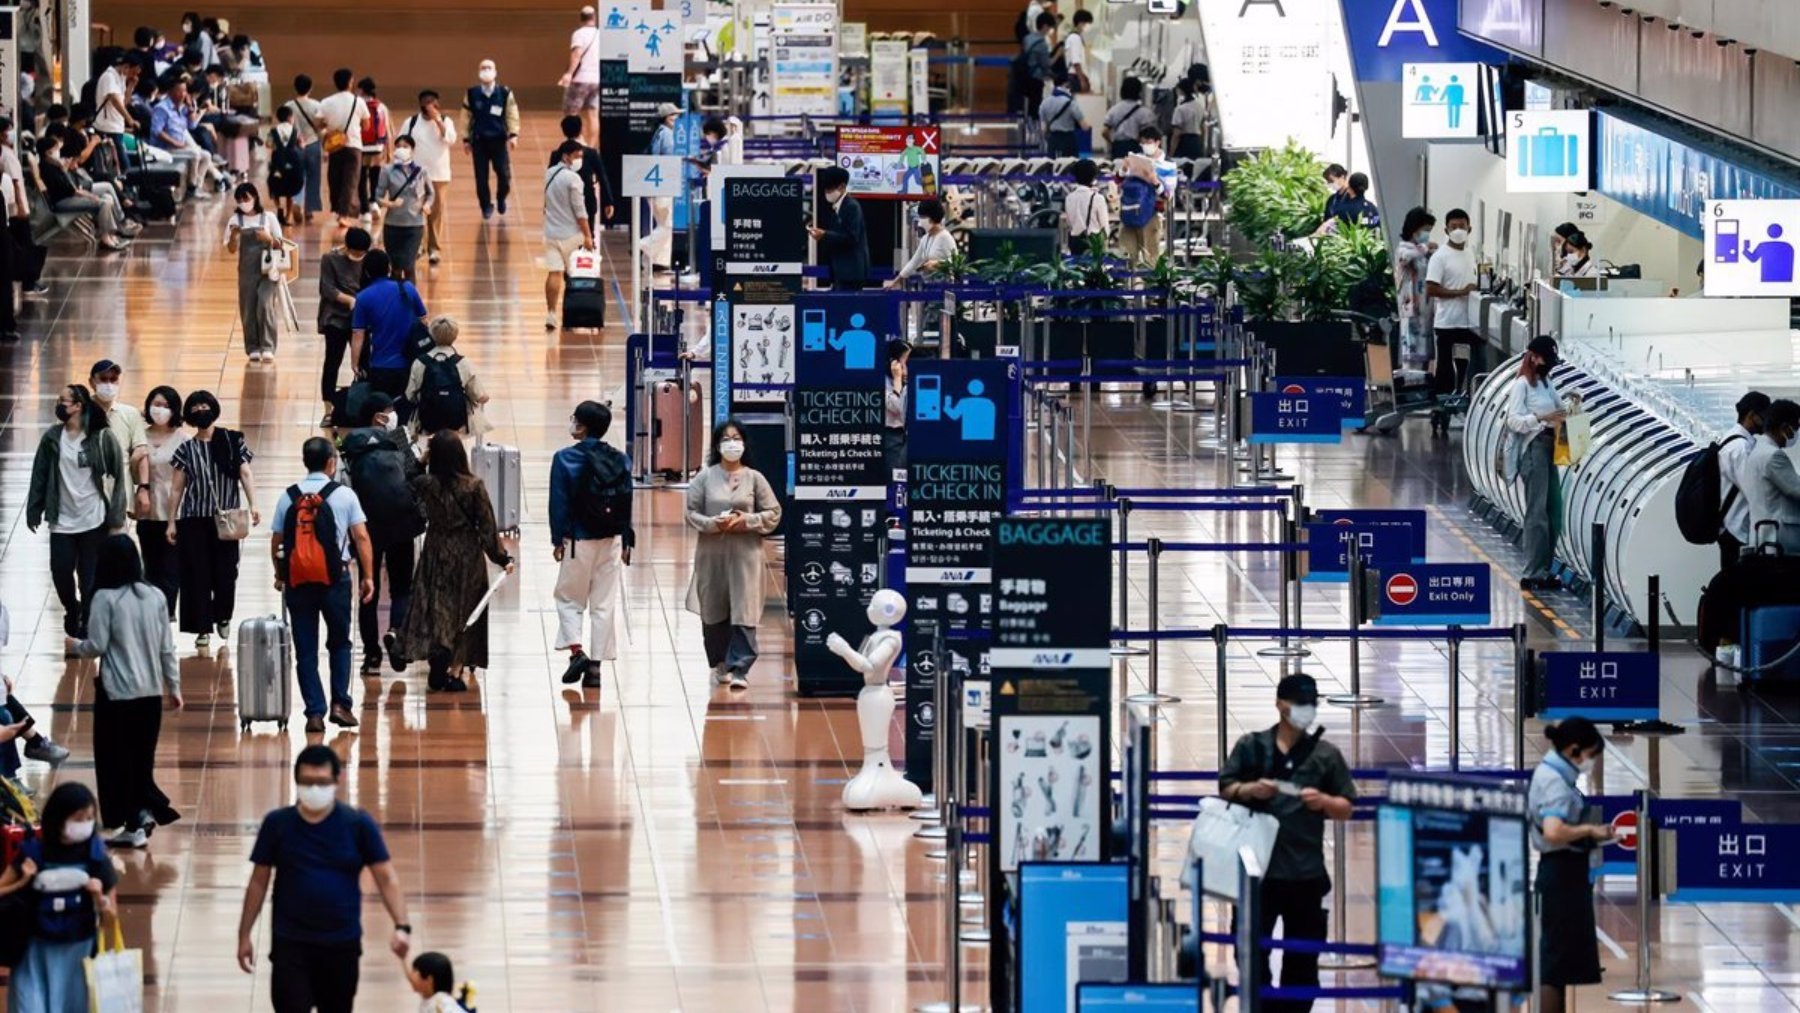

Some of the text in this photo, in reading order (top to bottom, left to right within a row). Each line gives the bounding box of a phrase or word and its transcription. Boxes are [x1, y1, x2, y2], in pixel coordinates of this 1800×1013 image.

[815, 12, 832, 21] DO
[1378, 0, 1440, 47] A
[1514, 113, 1523, 128] 5
[644, 164, 663, 187] 4
[732, 183, 798, 198] BAGGAGE
[1713, 203, 1724, 217] 6
[732, 218, 762, 229] 手荷物
[732, 231, 763, 241] Baggage
[753, 264, 771, 272] ANA
[801, 391, 882, 407] TICKETING
[1278, 399, 1309, 413] 出口
[864, 409, 882, 424] IN
[1278, 418, 1309, 428] EXIT
[801, 449, 882, 459] Ticketing & Check In
[912, 464, 1001, 481] TICKETING
[826, 489, 847, 497] ANA
[983, 483, 1001, 500] IN
[912, 527, 991, 538] Ticketing & Check
[999, 523, 1104, 545] BAGGAGE
[941, 571, 963, 581] ANA
[1429, 576, 1475, 588] 出口専用
[1000, 578, 1047, 595] 手荷物
[1429, 591, 1475, 603] Exit Only
[999, 599, 1048, 614] Baggage
[1033, 653, 1060, 664] ANA
[1579, 660, 1618, 680] 出口
[1579, 686, 1618, 699] EXIT
[1718, 833, 1766, 856] 出口
[1718, 863, 1766, 878] EXIT
